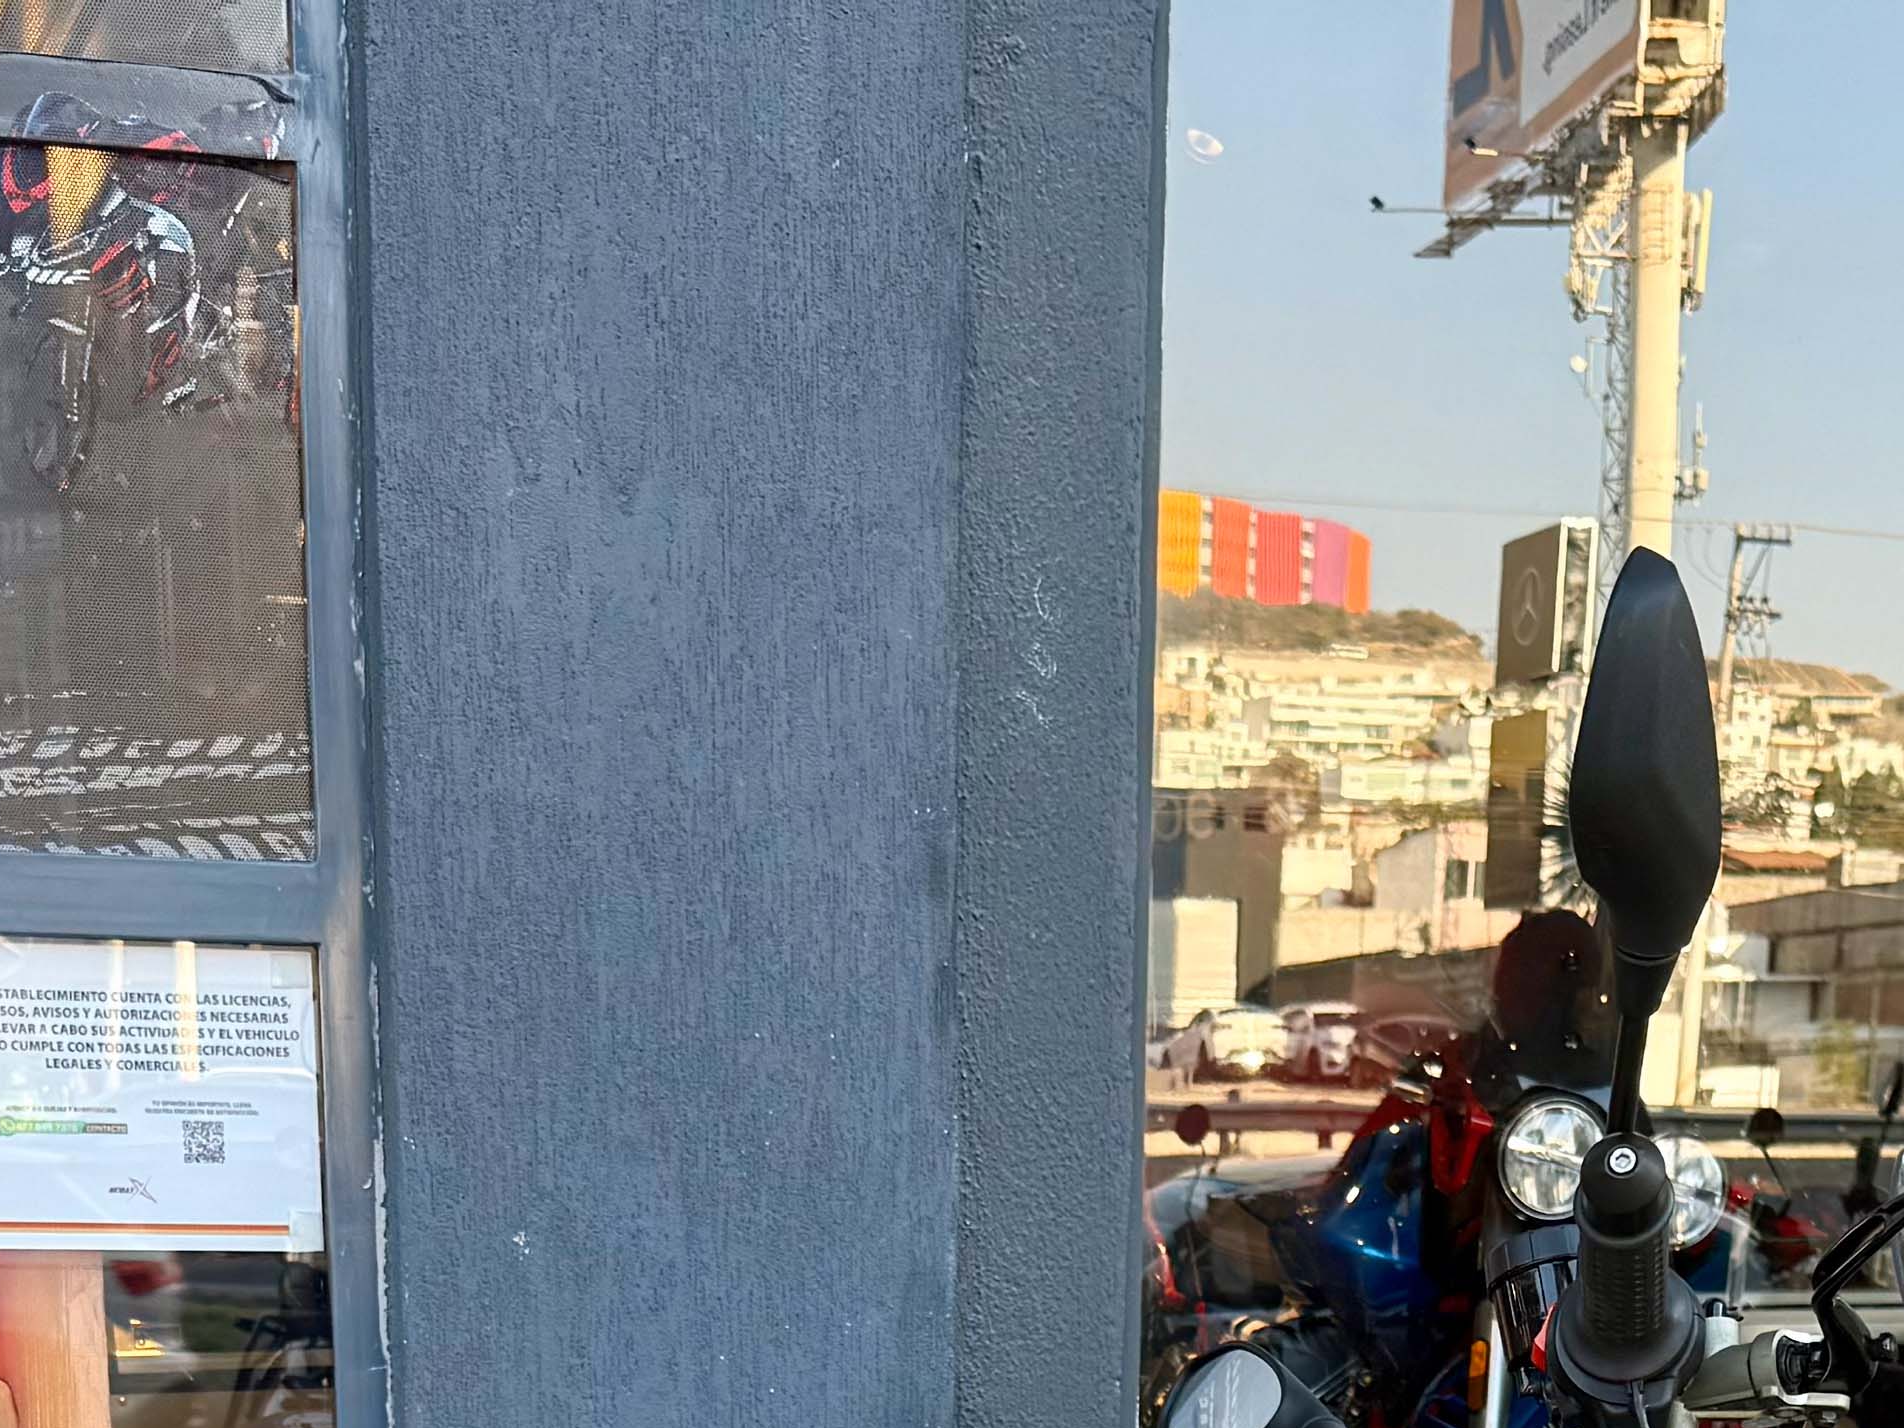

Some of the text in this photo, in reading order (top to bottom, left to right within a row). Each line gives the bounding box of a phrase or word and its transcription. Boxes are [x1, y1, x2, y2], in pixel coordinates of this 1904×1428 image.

[111, 991, 162, 1005] CUENTA
[196, 993, 220, 1006] LAS
[222, 994, 292, 1009] LICENCIAS,
[32, 1007, 81, 1019] AVISOS
[82, 1008, 92, 1019] Y
[210, 1011, 289, 1024] NECESARIAS
[38, 1023, 49, 1036] A
[51, 1024, 89, 1037] CABO
[91, 1025, 116, 1037] SUS
[118, 1026, 205, 1040] ACTIVIDADS
[207, 1028, 217, 1040] Y
[218, 1028, 233, 1040] EL
[234, 1028, 300, 1042] VEHICULO
[10, 1040, 65, 1053] CUMPLE
[67, 1041, 95, 1054] CON
[97, 1042, 141, 1055] TODAS
[143, 1042, 169, 1055] LAS
[45, 1058, 103, 1072] LEGALES
[103, 1060, 114, 1072] Y
